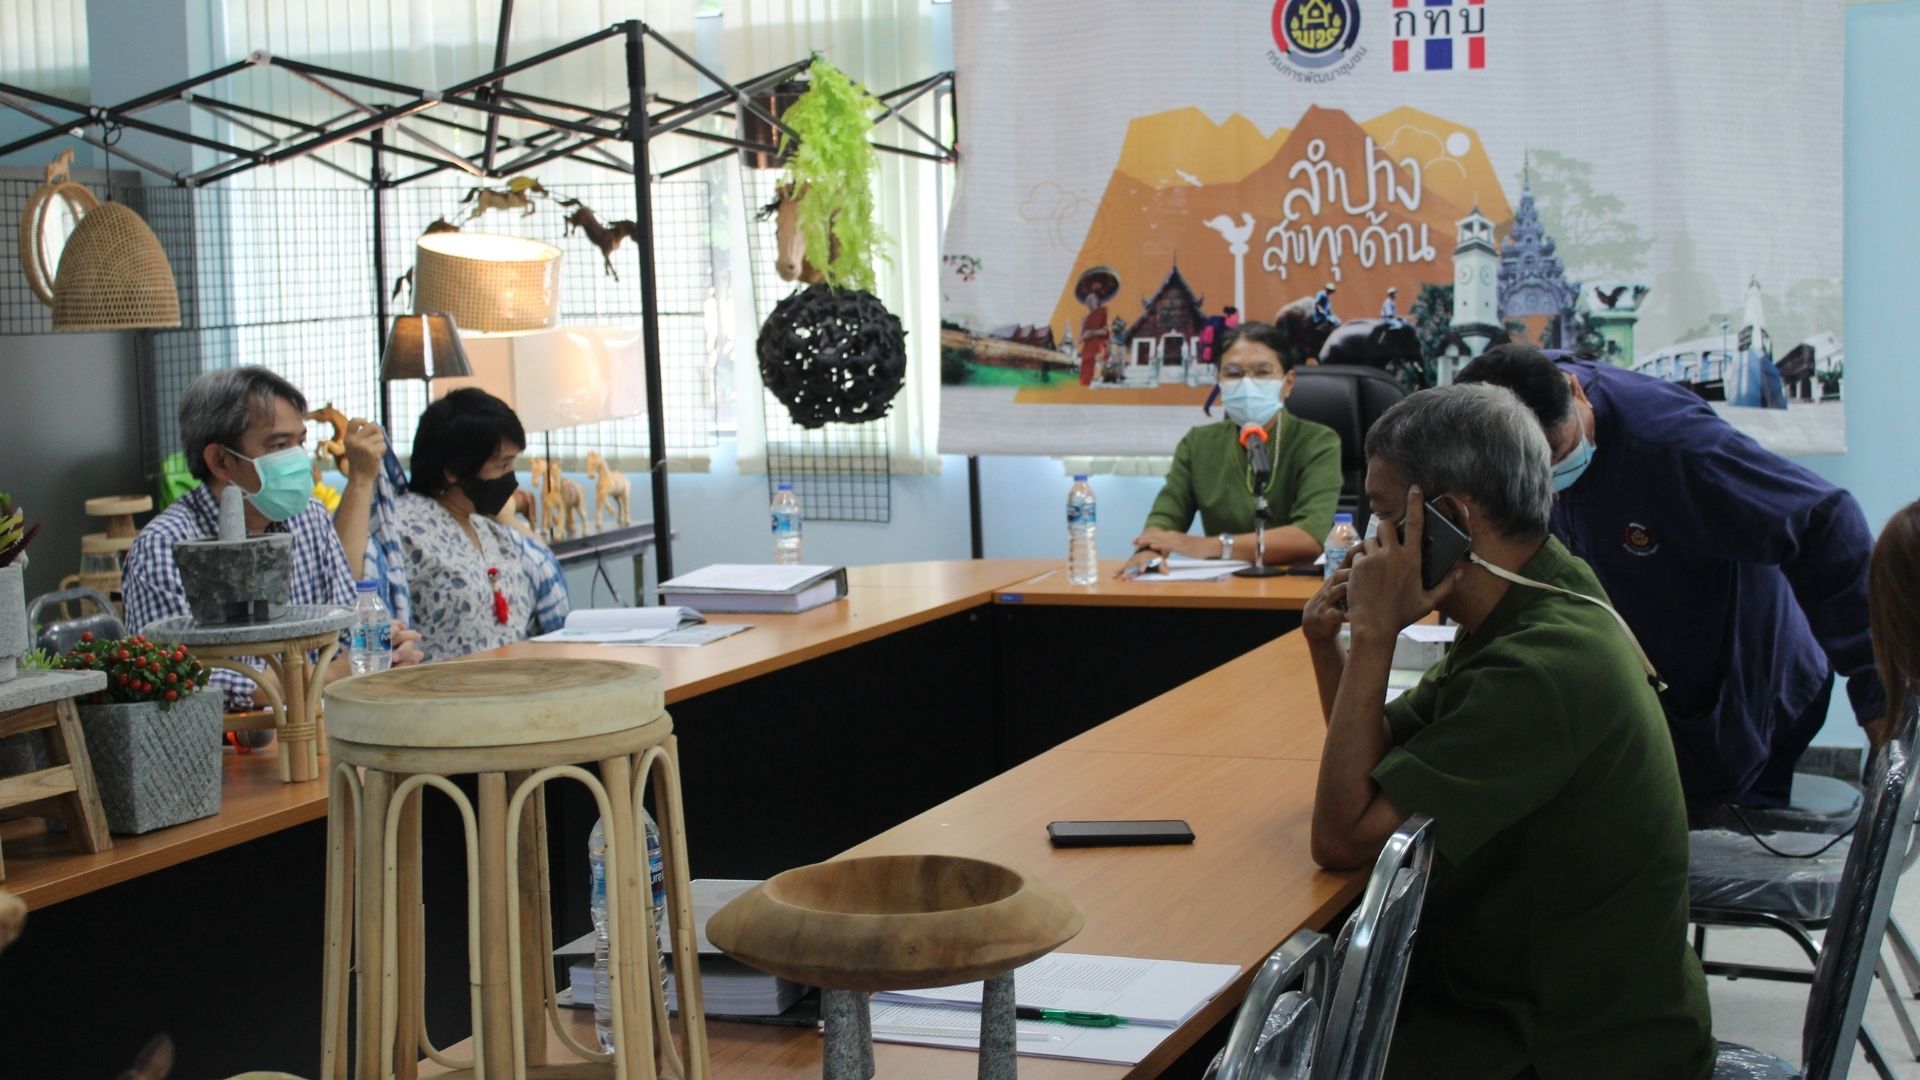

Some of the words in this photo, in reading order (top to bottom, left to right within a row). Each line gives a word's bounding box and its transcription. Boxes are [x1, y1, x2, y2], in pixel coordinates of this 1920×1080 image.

[1393, 7, 1485, 36] กทบ
[1282, 136, 1421, 220] ลำปาง
[1262, 211, 1436, 282] สุขทุกด้าน
